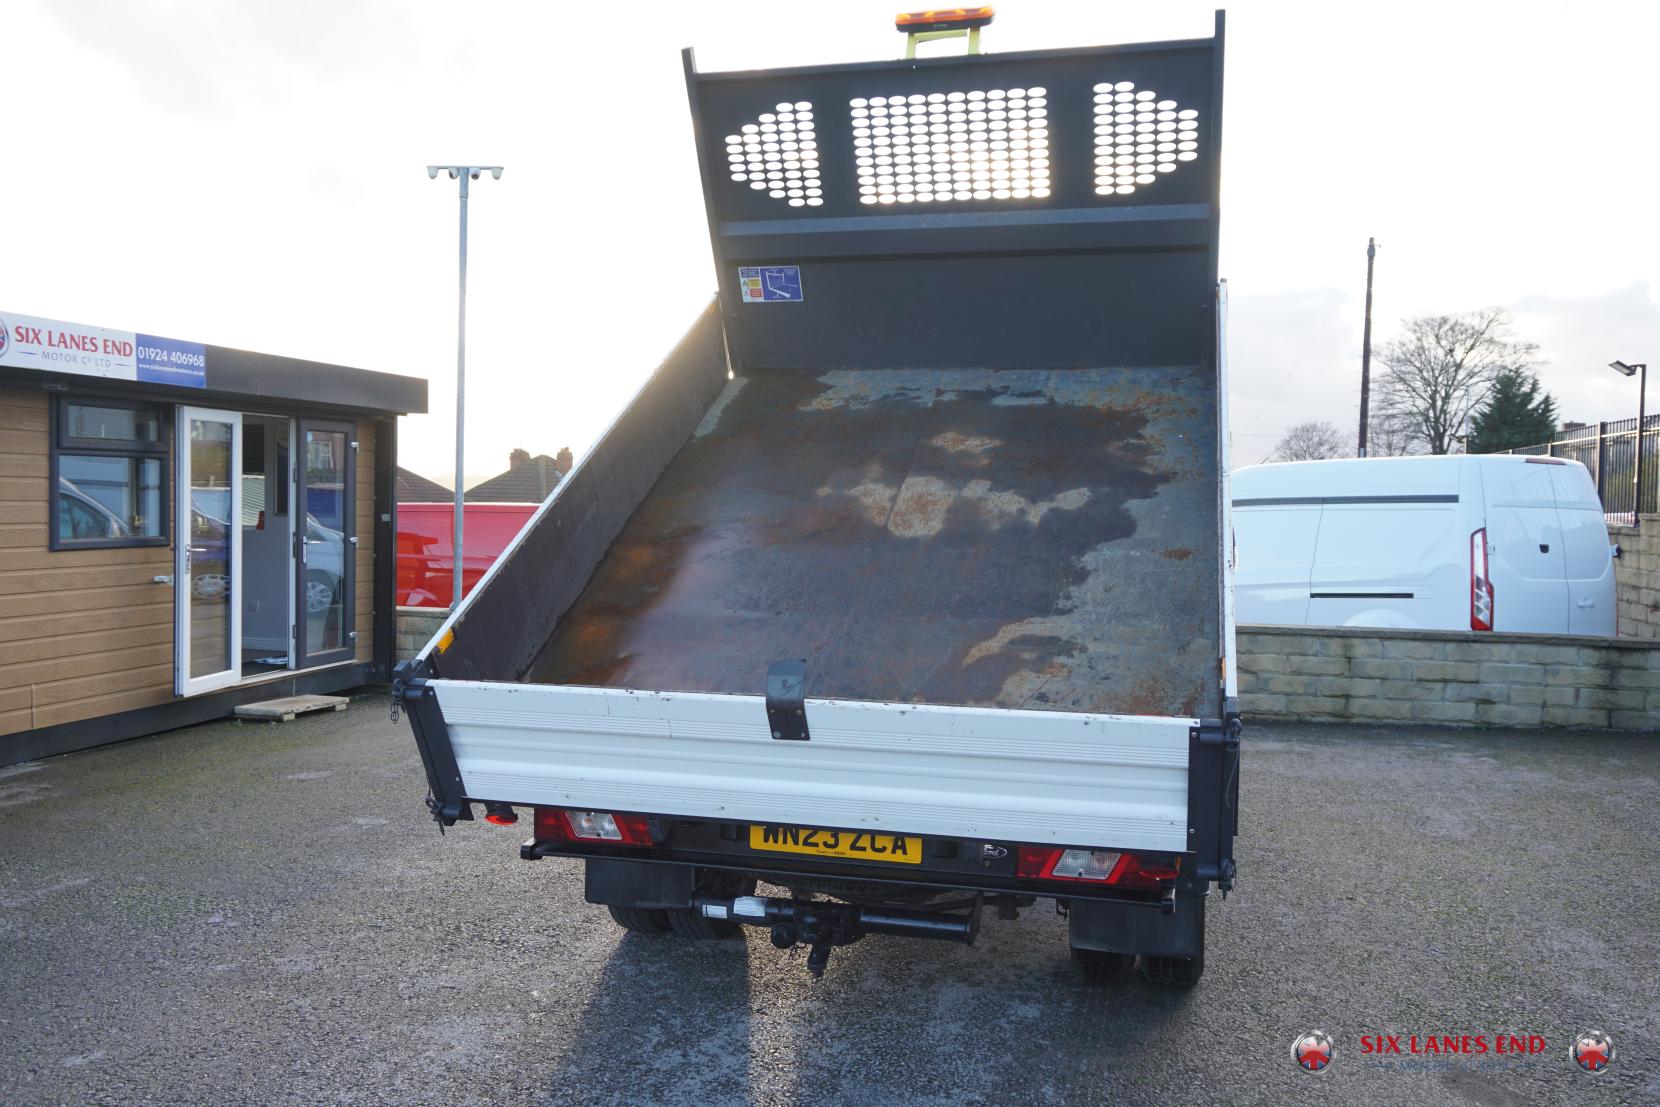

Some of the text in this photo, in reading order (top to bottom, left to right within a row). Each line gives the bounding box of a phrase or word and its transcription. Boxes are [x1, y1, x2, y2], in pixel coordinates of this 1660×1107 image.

[15, 325, 133, 357] SIX LANES END
[41, 351, 78, 365] MOTOR
[95, 358, 111, 368] LTD
[138, 346, 205, 367] 01924 406968
[763, 825, 908, 856] WN23 ZCA
